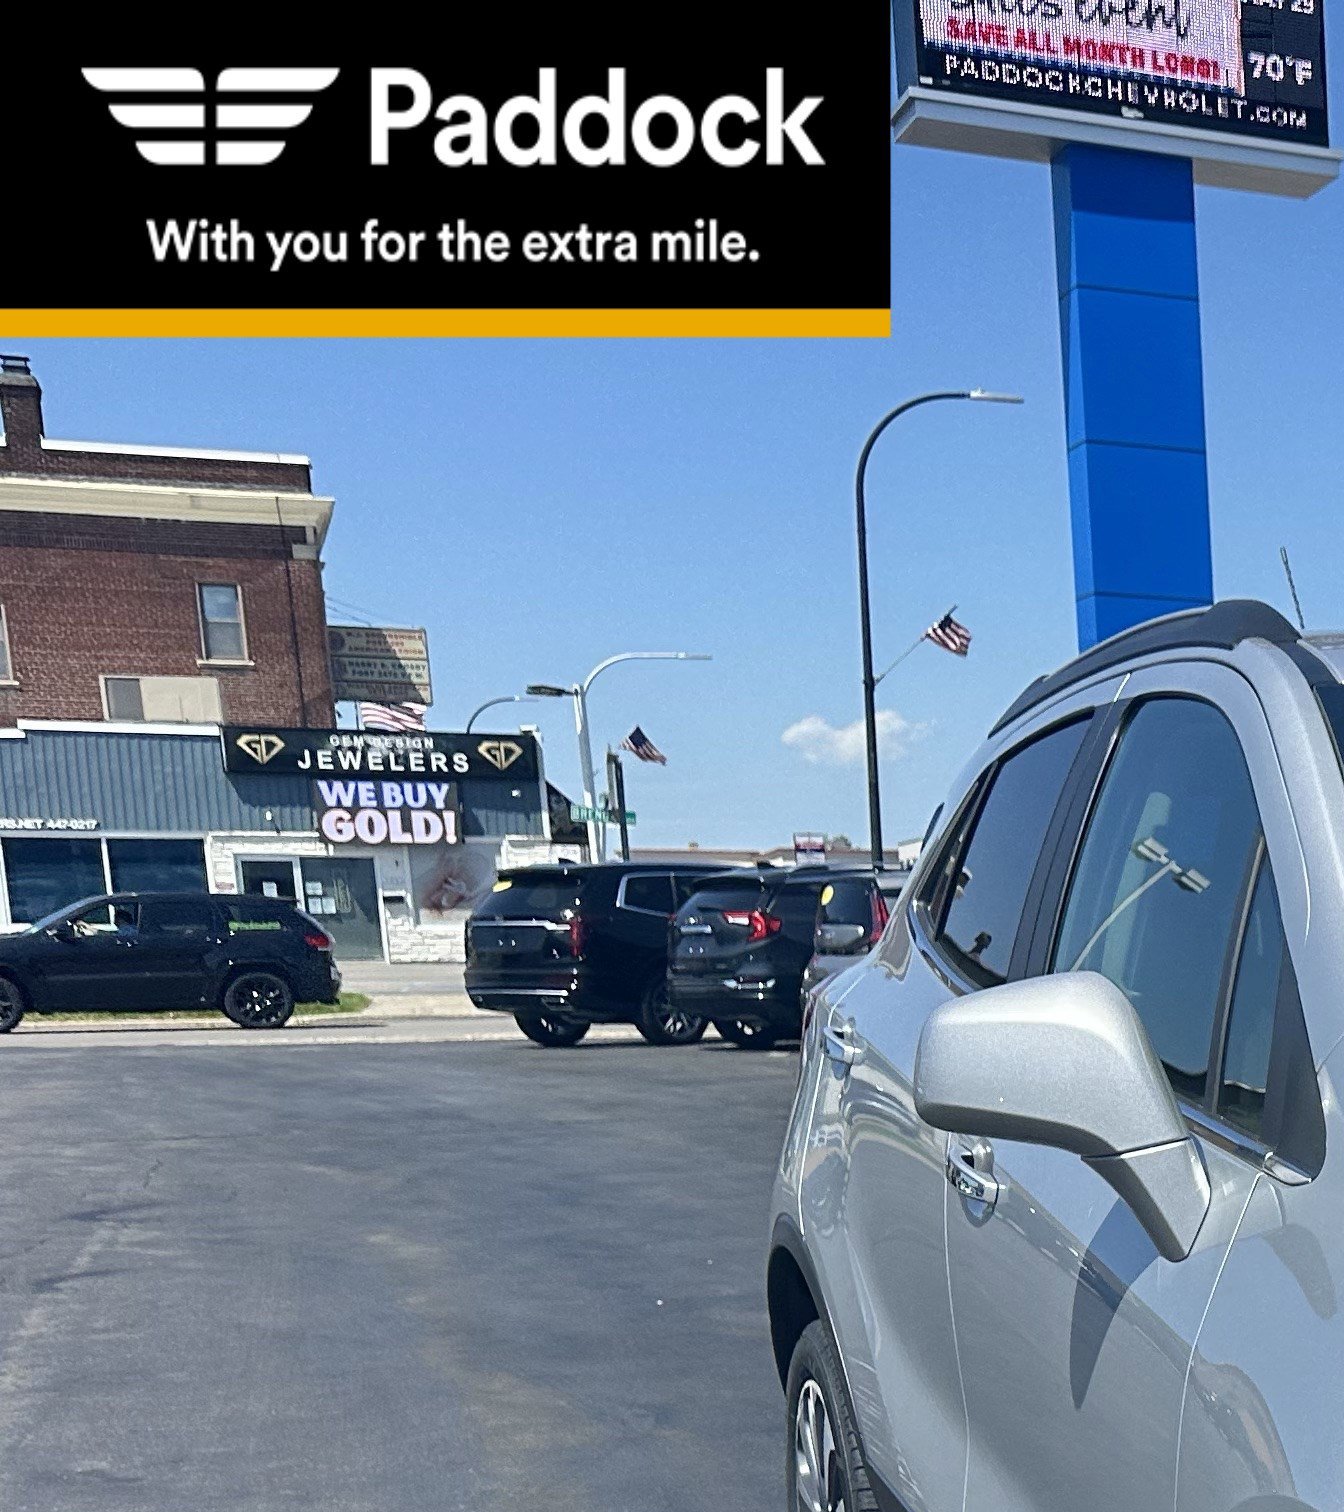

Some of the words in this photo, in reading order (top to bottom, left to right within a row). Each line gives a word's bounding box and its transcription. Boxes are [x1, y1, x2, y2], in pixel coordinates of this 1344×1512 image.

[946, 16, 1008, 46] SAVE
[1014, 28, 1057, 55] ALL
[1062, 36, 1145, 69] MONTH
[945, 53, 1308, 130] PADDOCKCHEVROLET.COM
[297, 749, 470, 773] JEWELERS
[316, 780, 376, 808] WE
[382, 781, 450, 810] BUY
[321, 808, 458, 845] GOLD!
